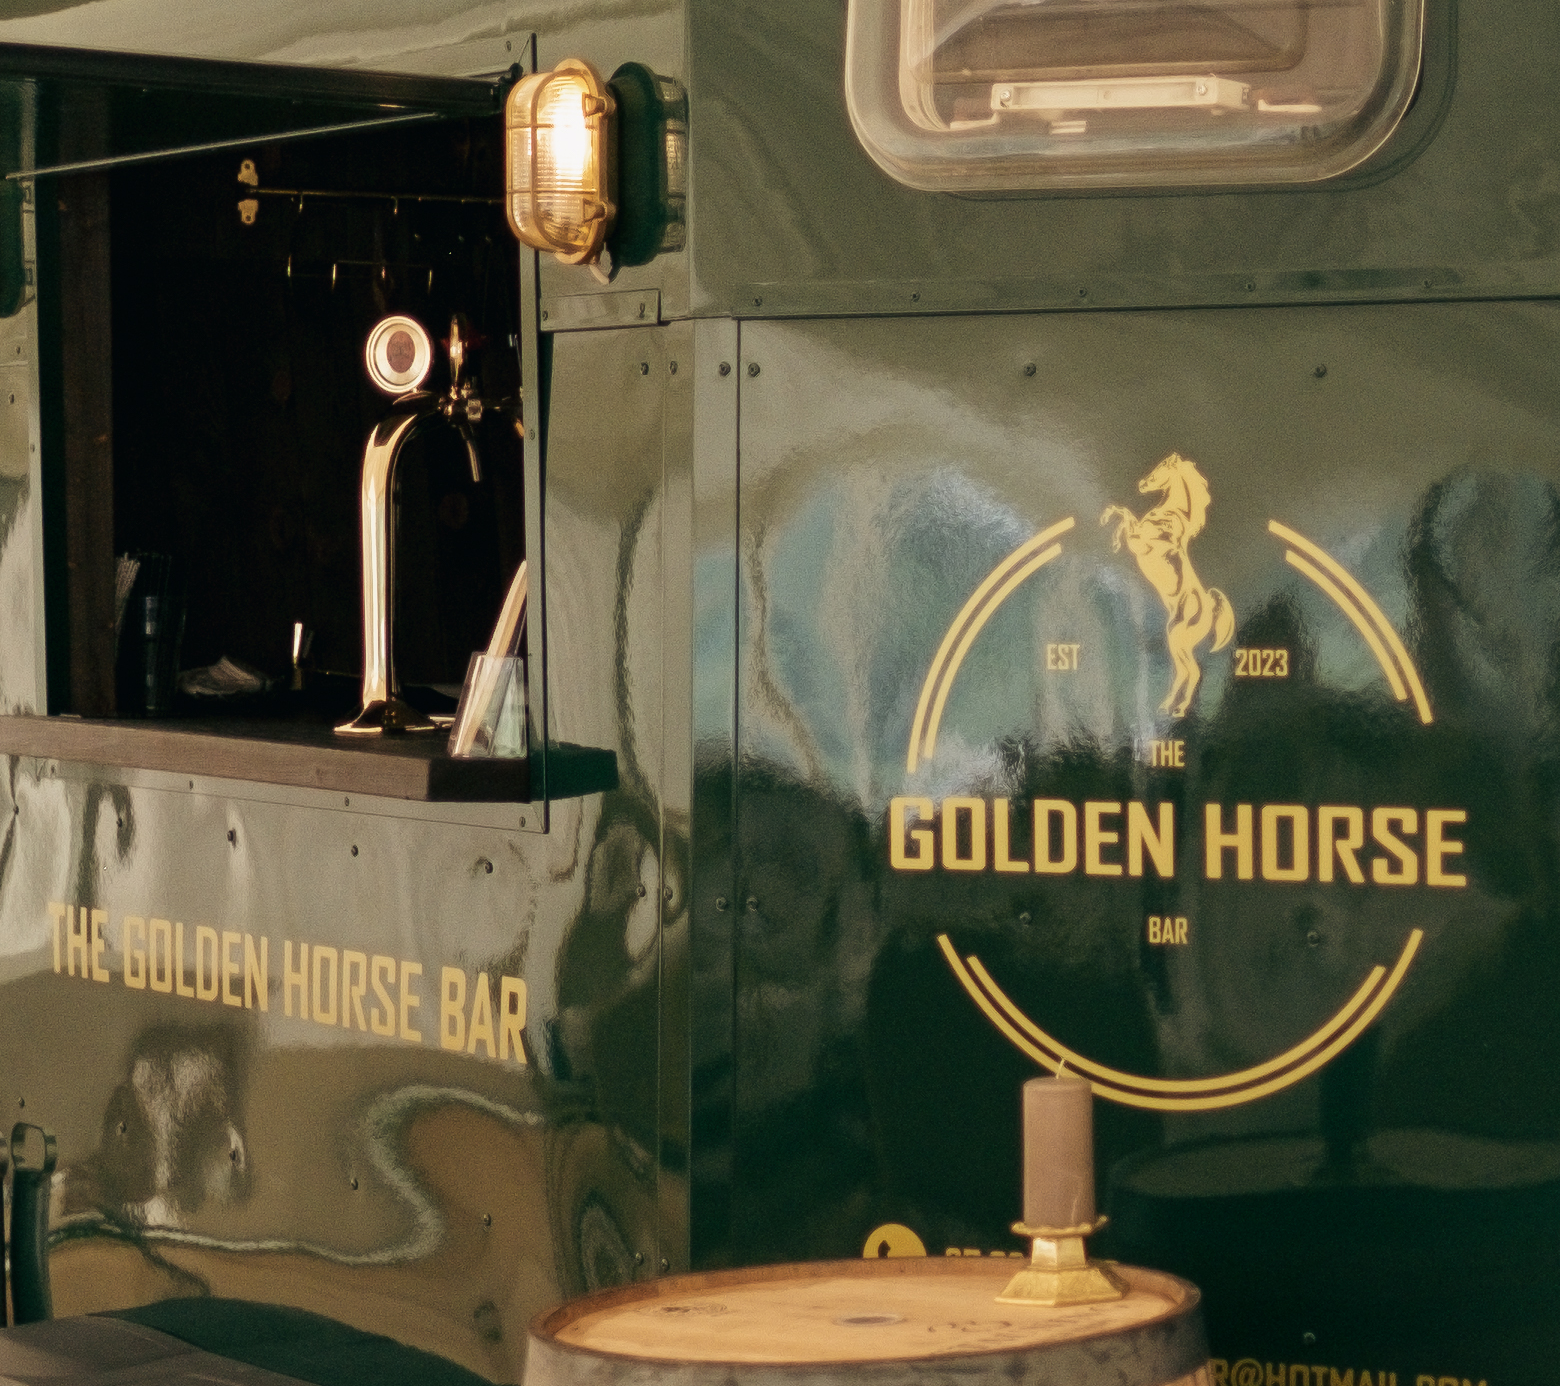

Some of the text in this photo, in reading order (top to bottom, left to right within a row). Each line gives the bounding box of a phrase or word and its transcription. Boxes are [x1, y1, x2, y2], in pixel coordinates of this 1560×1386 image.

[1046, 645, 1289, 678] EST 2023
[1148, 740, 1186, 769] THE
[889, 795, 1468, 888] GOLDEN HORSE
[1148, 916, 1188, 945] BAR
[47, 901, 529, 1065] THE GOLDEN HORSE BAR
